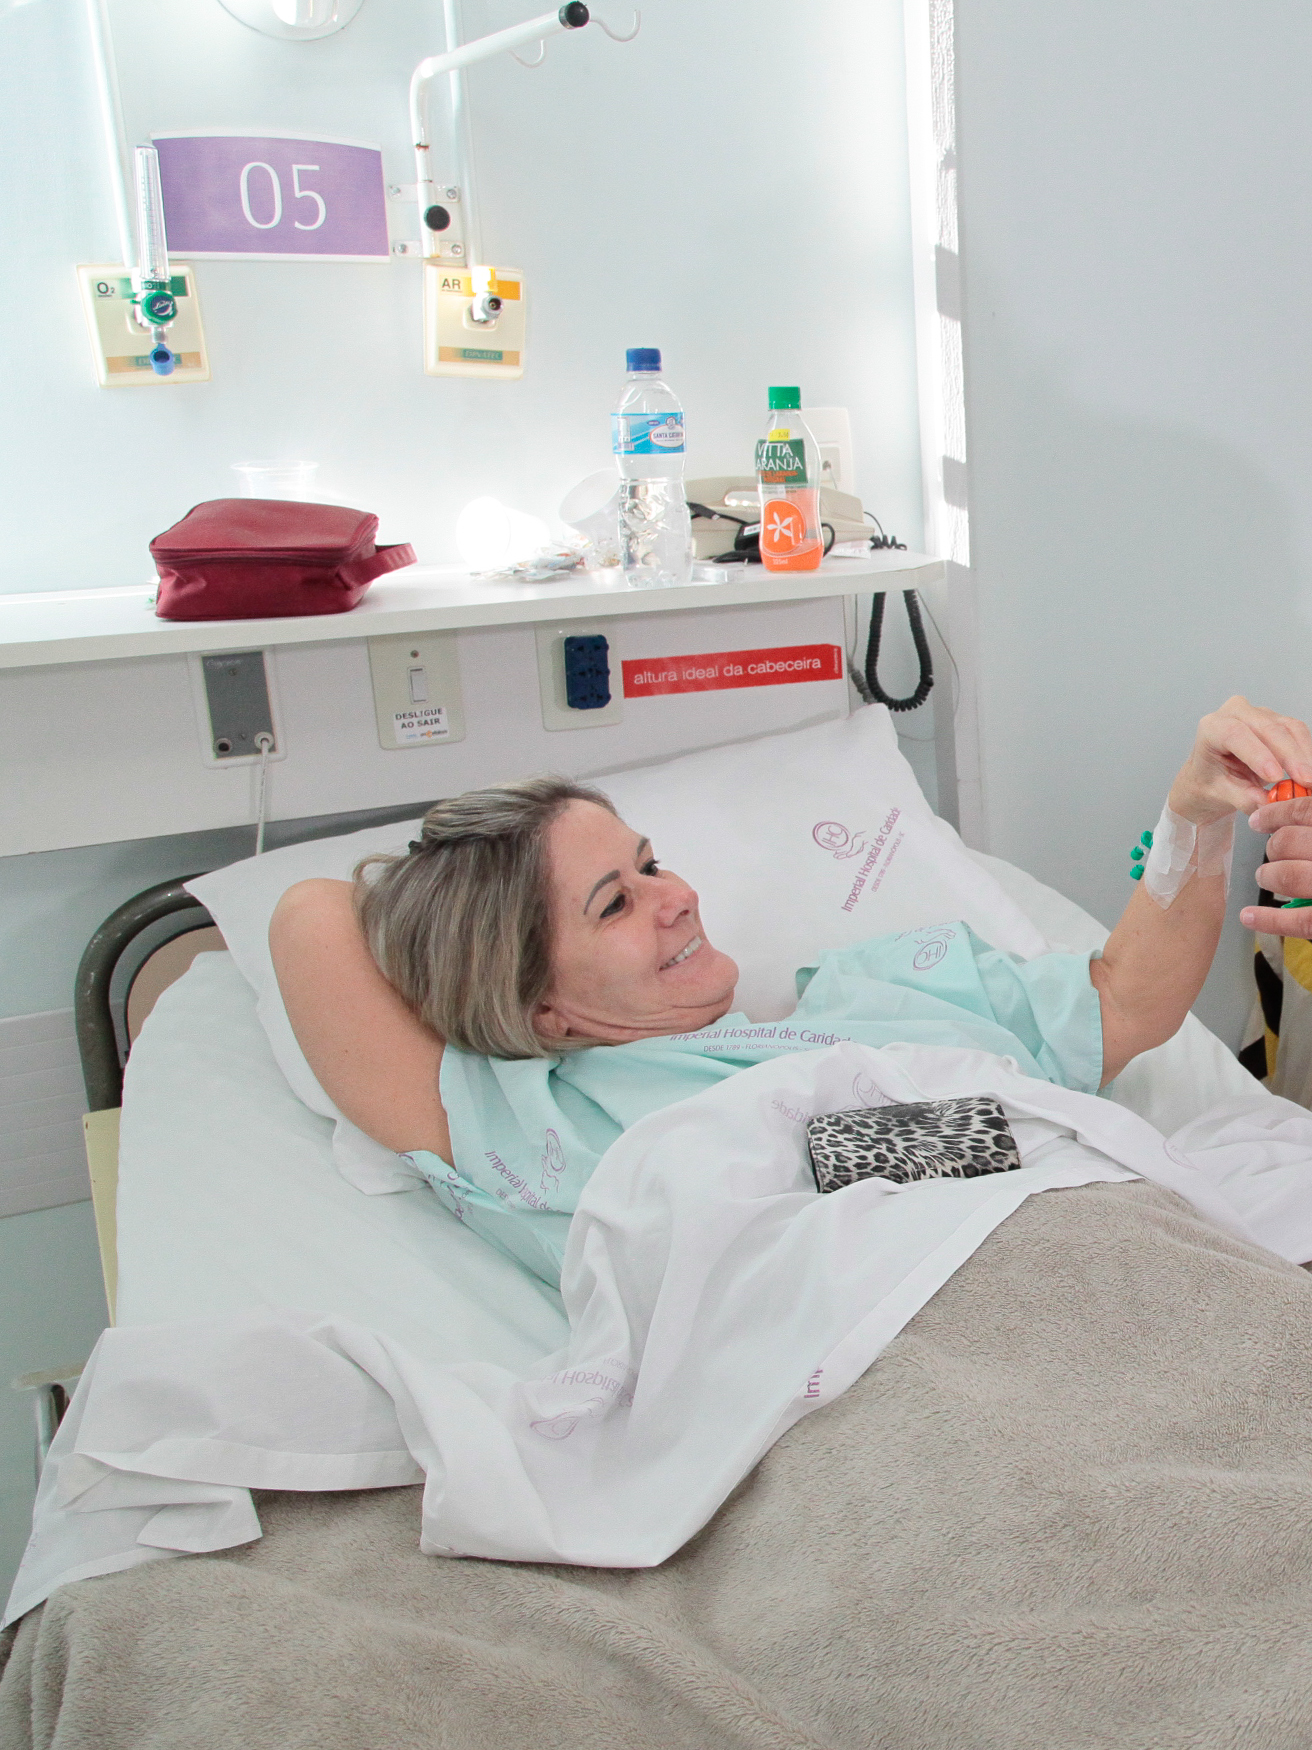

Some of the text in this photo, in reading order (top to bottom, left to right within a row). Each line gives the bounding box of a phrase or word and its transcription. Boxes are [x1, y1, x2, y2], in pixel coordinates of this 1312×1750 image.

[240, 161, 327, 231] 05
[441, 278, 462, 290] AR
[755, 457, 804, 471] ARANJA
[634, 669, 677, 685] altura
[682, 665, 719, 681] ideal
[723, 663, 744, 677] da
[747, 657, 822, 675] cabeceira
[395, 707, 443, 721] DESLIGUE
[401, 717, 441, 729] AO SAIR
[840, 875, 867, 912] Imperial
[858, 845, 882, 877] Hospital
[874, 835, 888, 847] de
[723, 1027, 777, 1040] Hospital
[779, 1027, 797, 1040] de
[704, 1045, 724, 1053] DESDE
[484, 1150, 525, 1189] Imperial
